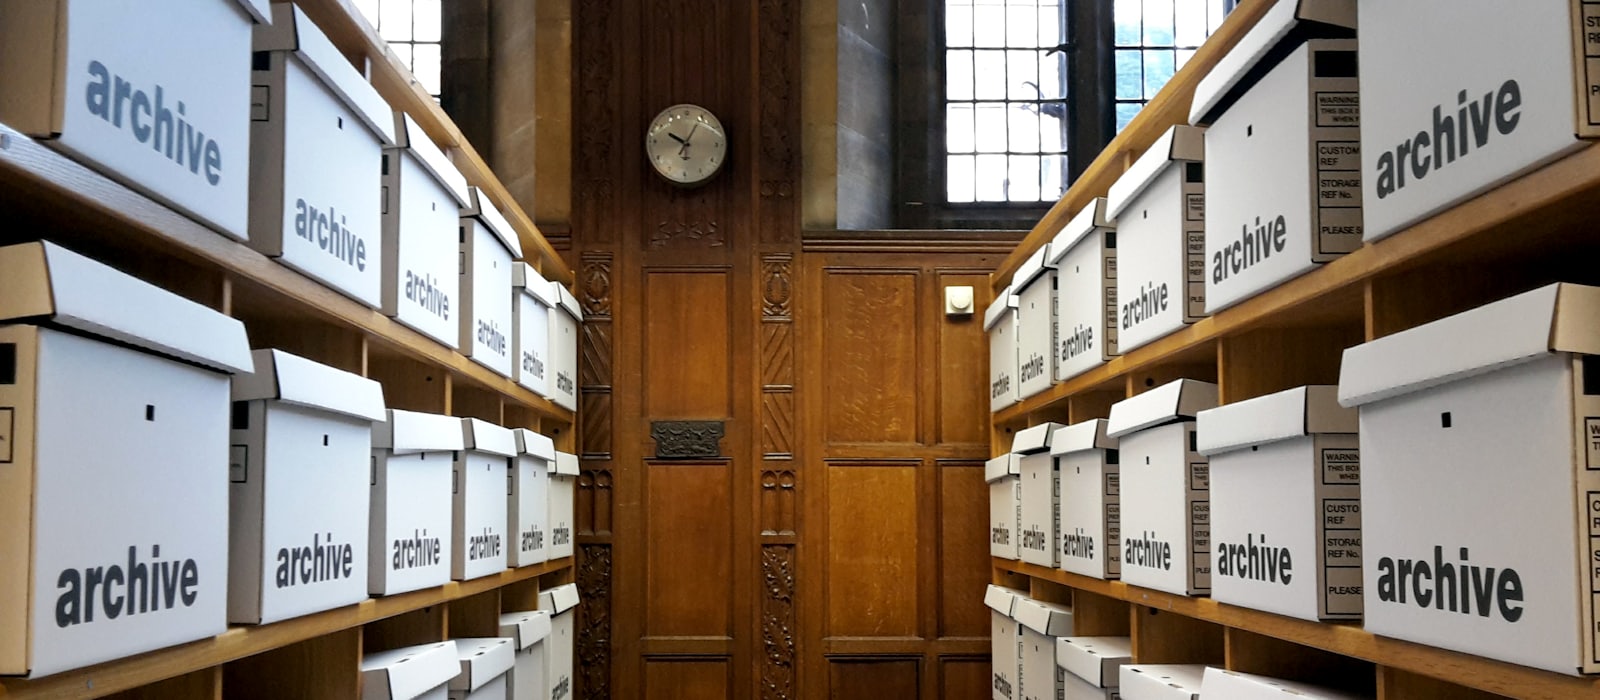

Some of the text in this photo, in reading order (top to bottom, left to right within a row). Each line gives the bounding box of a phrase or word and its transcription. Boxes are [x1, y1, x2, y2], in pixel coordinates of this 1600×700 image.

[86, 60, 222, 186] archive
[1376, 79, 1521, 199] archive
[295, 198, 366, 272] archive
[1213, 214, 1286, 285] archive
[405, 269, 449, 321] archive
[1122, 281, 1168, 330] archive
[477, 319, 506, 357] archive
[1062, 324, 1093, 362] archive
[1021, 353, 1044, 383] archive
[1326, 505, 1359, 513] CUSTO
[1327, 516, 1344, 524] REF
[393, 529, 440, 570] archive
[469, 527, 500, 561] archive
[522, 524, 543, 552] archive
[992, 522, 1009, 546] archive
[1023, 525, 1045, 551] archive
[1063, 527, 1094, 560] archive
[1125, 531, 1171, 571] archive
[1328, 550, 1359, 558] REF No.
[276, 532, 353, 588] archive
[1218, 534, 1292, 585] archive
[55, 544, 198, 628] archive
[1378, 545, 1523, 623] archive
